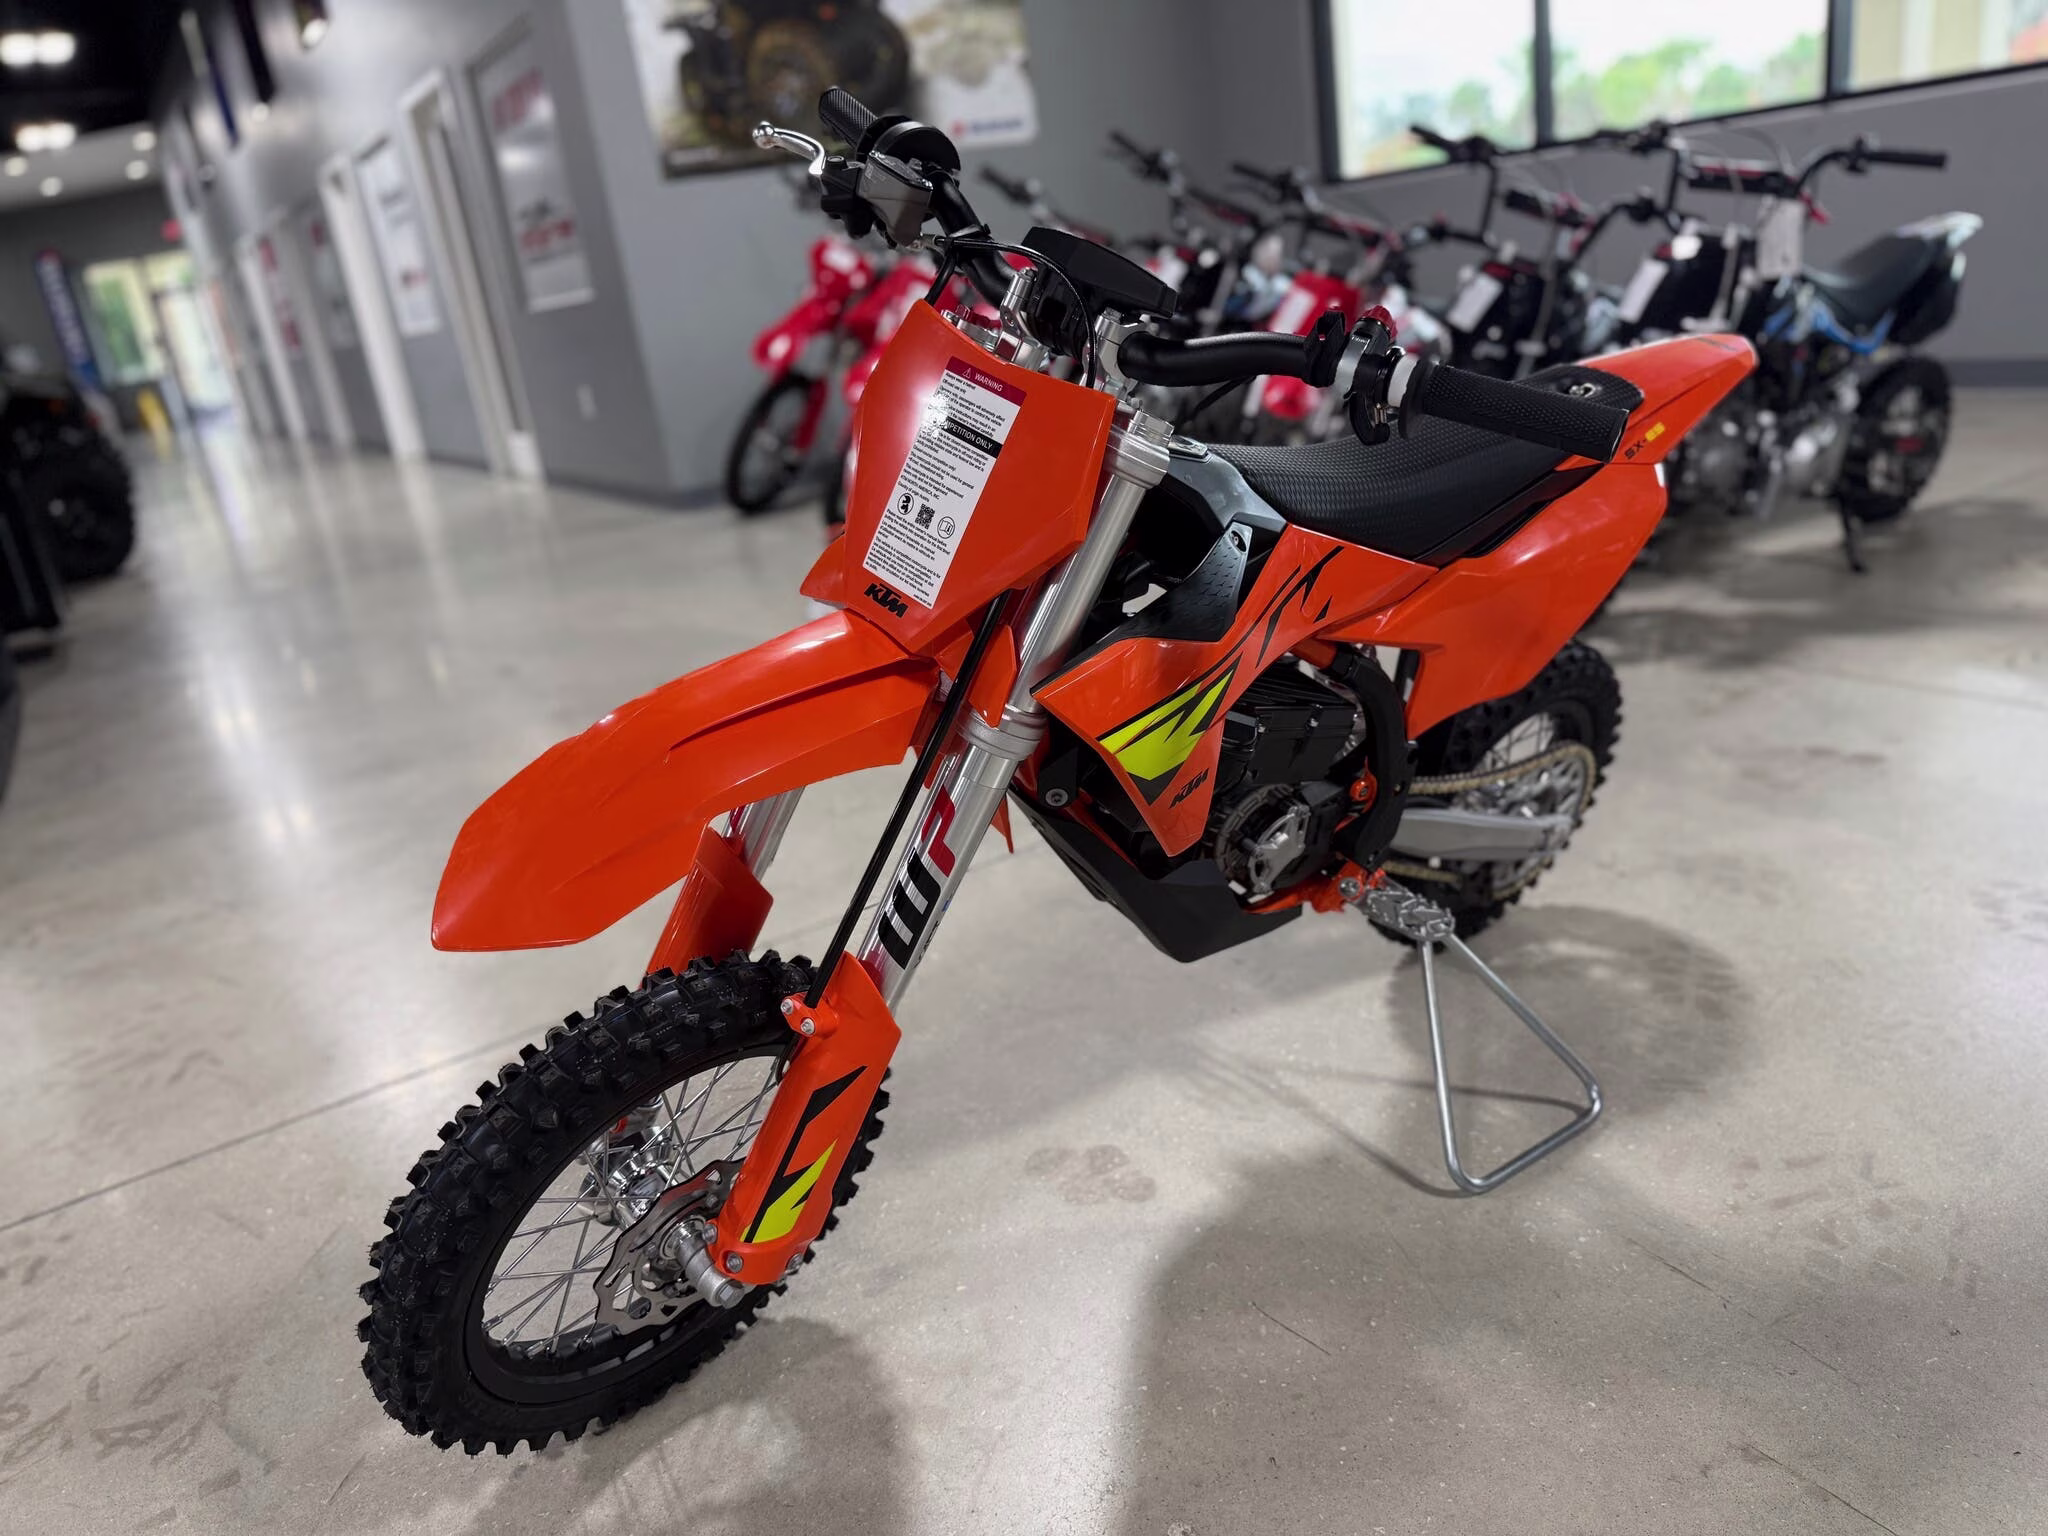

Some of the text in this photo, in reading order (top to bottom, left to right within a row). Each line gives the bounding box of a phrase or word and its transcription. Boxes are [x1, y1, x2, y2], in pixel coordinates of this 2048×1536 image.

[974, 374, 1003, 392] WARNING
[974, 436, 992, 450] ONLY
[864, 583, 908, 618] KTM
[1168, 767, 1209, 809] KTM
[878, 785, 956, 970] WP
